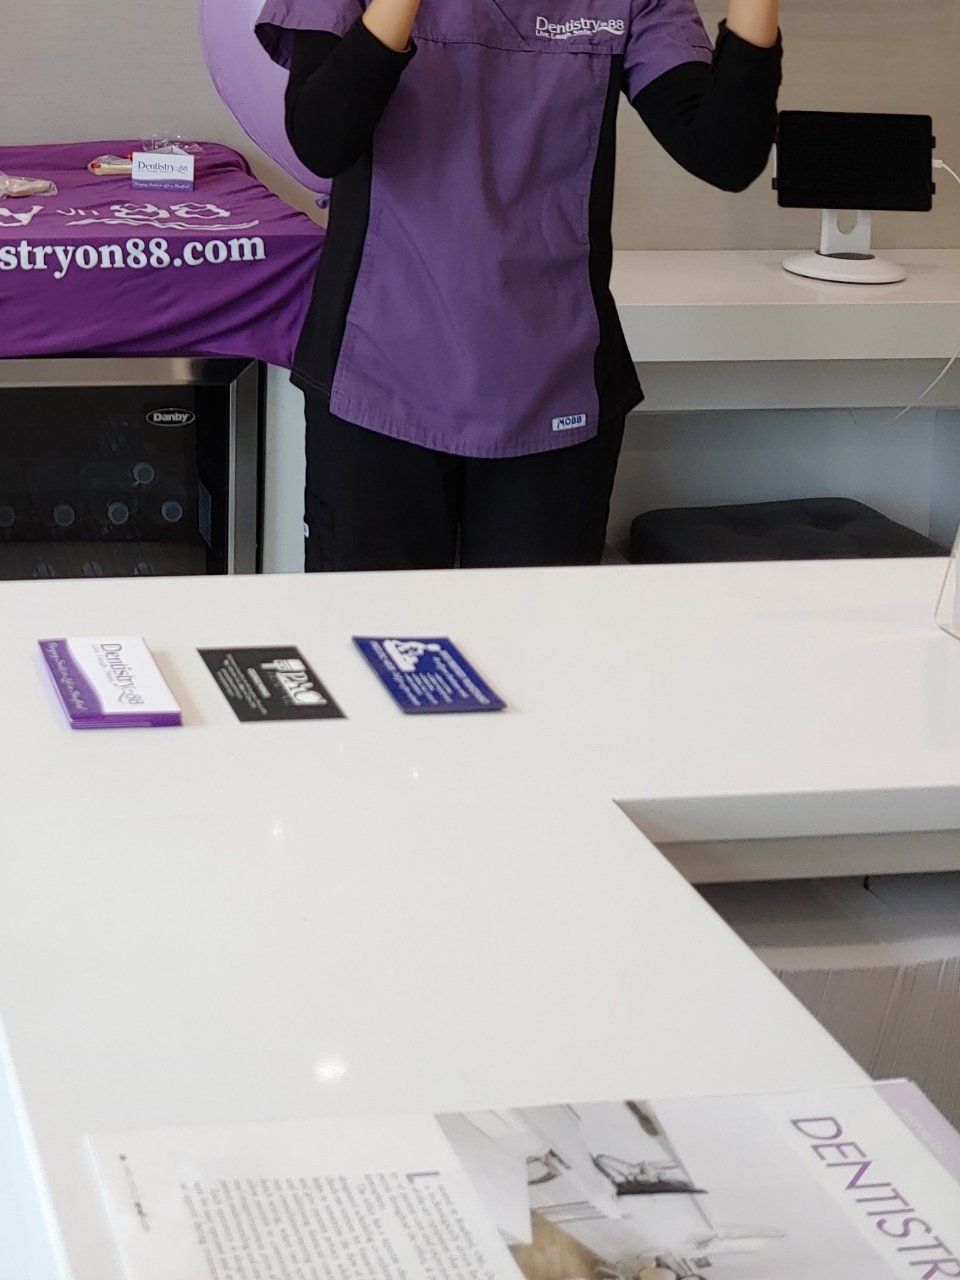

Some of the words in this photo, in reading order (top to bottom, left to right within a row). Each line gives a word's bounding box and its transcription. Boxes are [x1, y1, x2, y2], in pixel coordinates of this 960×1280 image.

[536, 16, 600, 33] Dentistry
[138, 160, 175, 173] Dentistry
[153, 411, 189, 422] Danby
